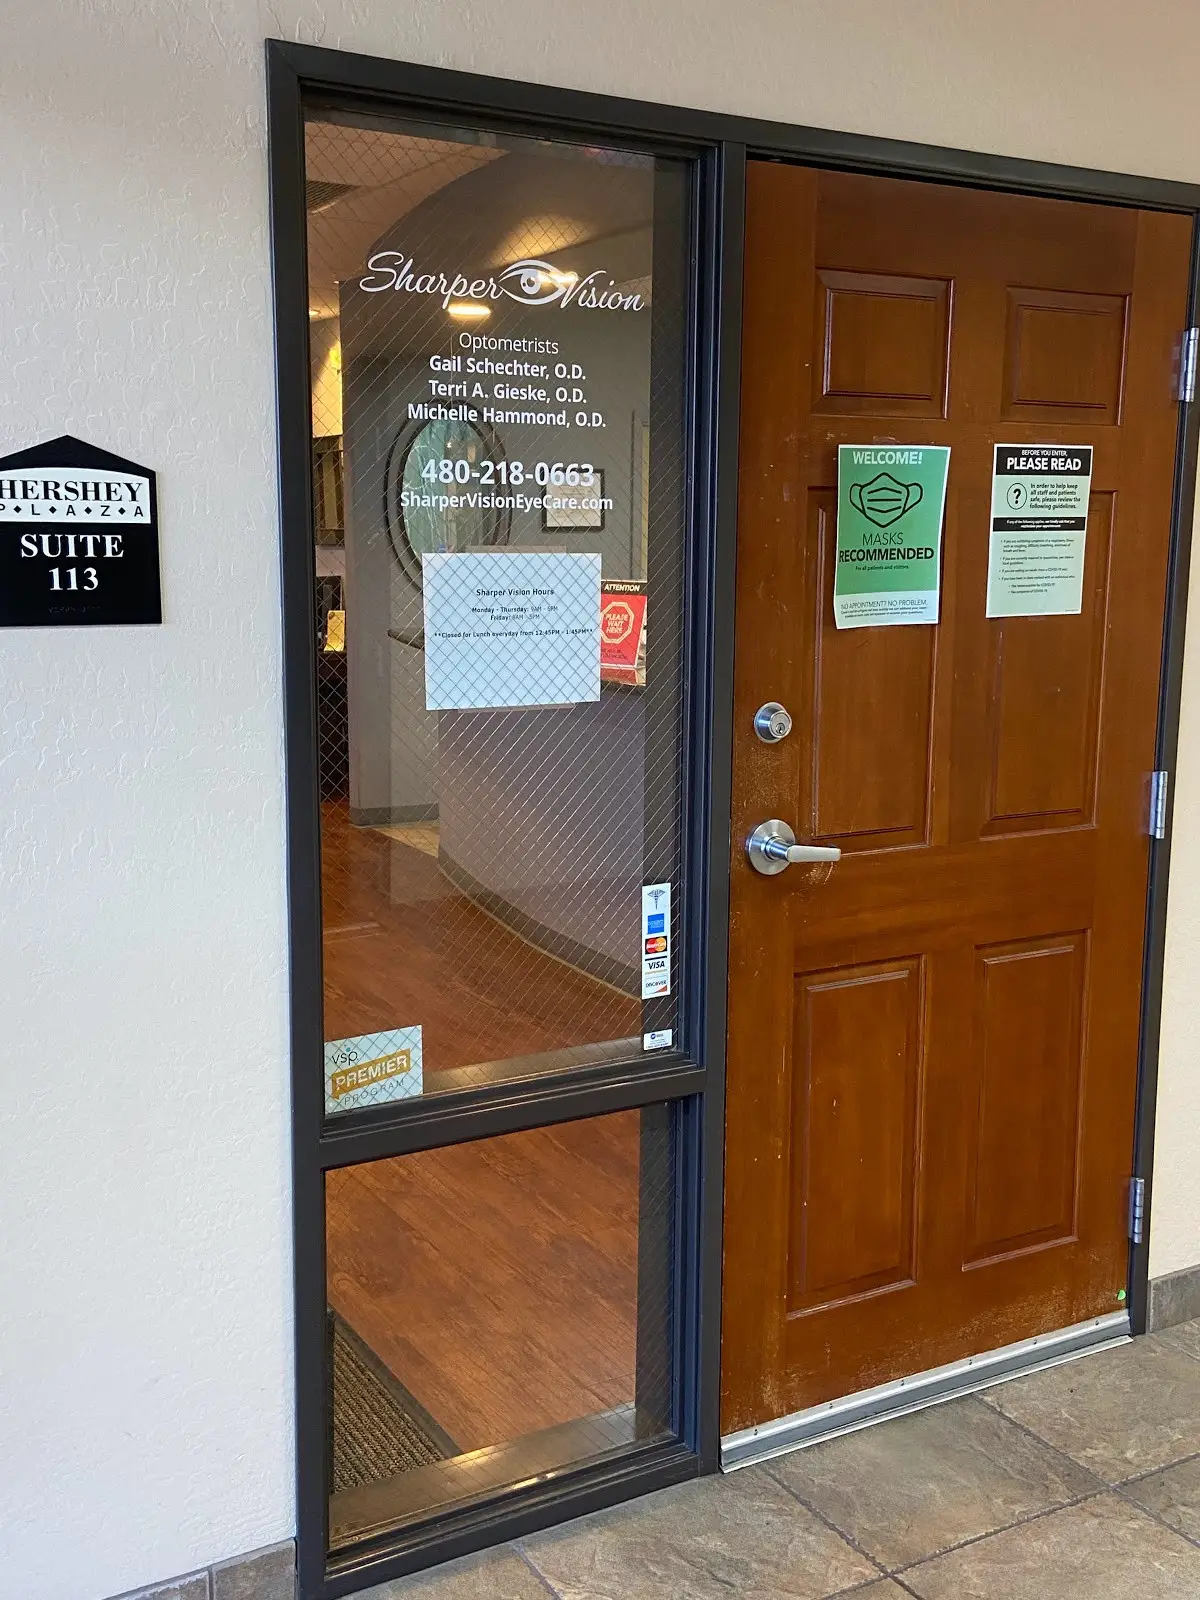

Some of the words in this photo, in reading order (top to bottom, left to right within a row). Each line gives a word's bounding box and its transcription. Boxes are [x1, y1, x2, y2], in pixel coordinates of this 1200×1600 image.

[360, 251, 503, 310] Sharper
[560, 270, 645, 312] Vision
[459, 333, 559, 354] Optometrists
[429, 355, 462, 373] Gail
[466, 357, 550, 379] Schechter,
[554, 363, 586, 380] O.D.
[429, 380, 466, 398] Terri
[472, 382, 488, 398] A.
[494, 383, 550, 403] Gieske,
[555, 387, 587, 404] O.D.
[407, 403, 478, 422] Michelle
[483, 406, 570, 429] Hammond,
[575, 411, 606, 428] O.D.
[853, 451, 923, 465] WELCOME!
[1007, 457, 1048, 470] PLEASE
[1051, 458, 1081, 470] READ
[421, 459, 595, 487] 480-218-0663
[0, 480, 143, 502] HERSHEY
[400, 491, 613, 513] SharperVisionEyeCare.com
[20, 534, 124, 558] SUITE
[862, 532, 904, 546] MASKS
[839, 547, 934, 563] RECOMMENDED
[49, 567, 99, 591] 113
[604, 584, 640, 592] ATTENTION
[476, 589, 506, 598] Sharper
[849, 601, 887, 609] APPOINTMENT?
[648, 961, 665, 969] VISA
[331, 1051, 358, 1065] vsp
[336, 1054, 407, 1090] PREMIER
[344, 1078, 404, 1105] PROGRAM
